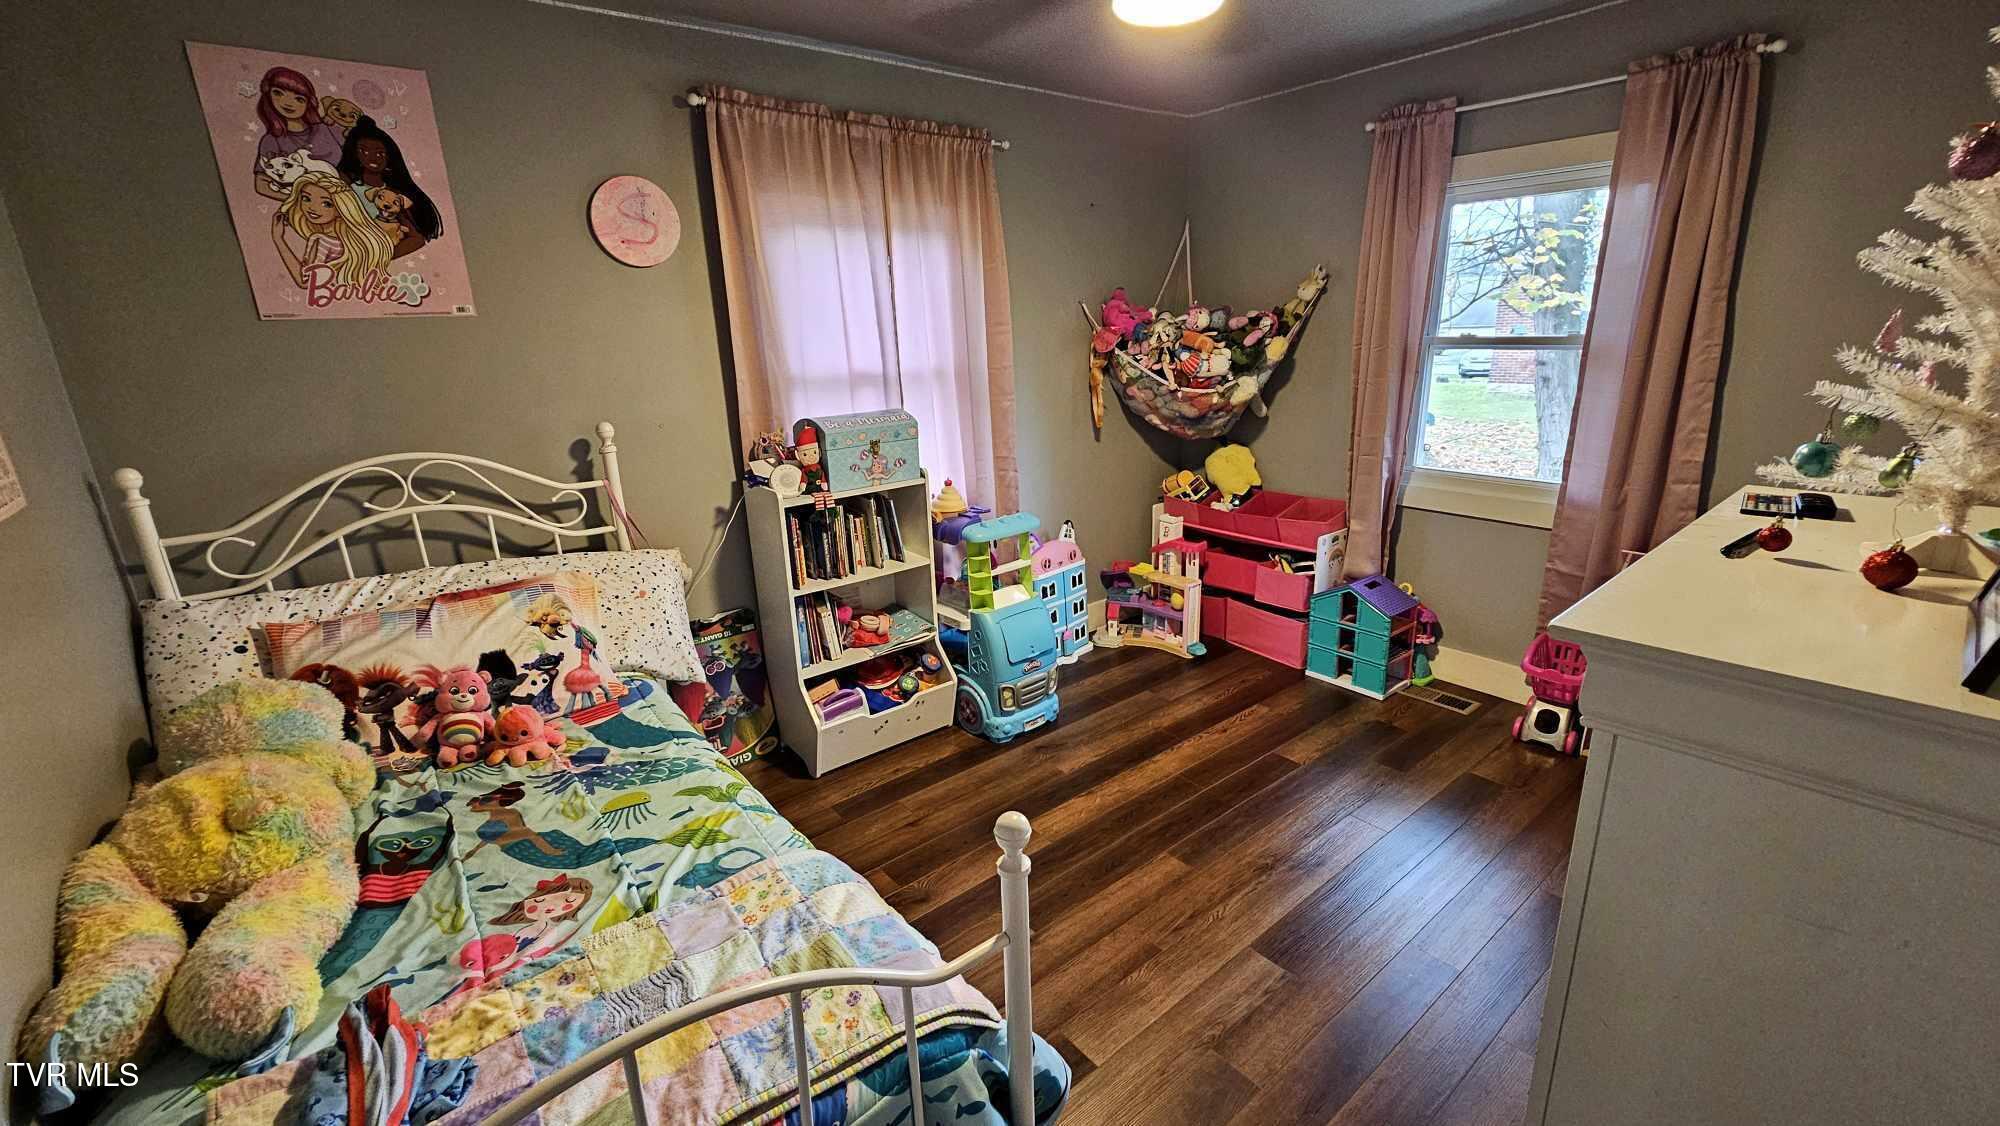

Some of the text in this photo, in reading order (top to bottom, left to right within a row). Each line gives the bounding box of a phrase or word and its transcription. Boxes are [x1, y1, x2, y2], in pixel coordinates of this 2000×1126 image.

[303, 263, 408, 308] Barbie
[701, 632, 722, 642] GIANT
[730, 752, 752, 766] GIA
